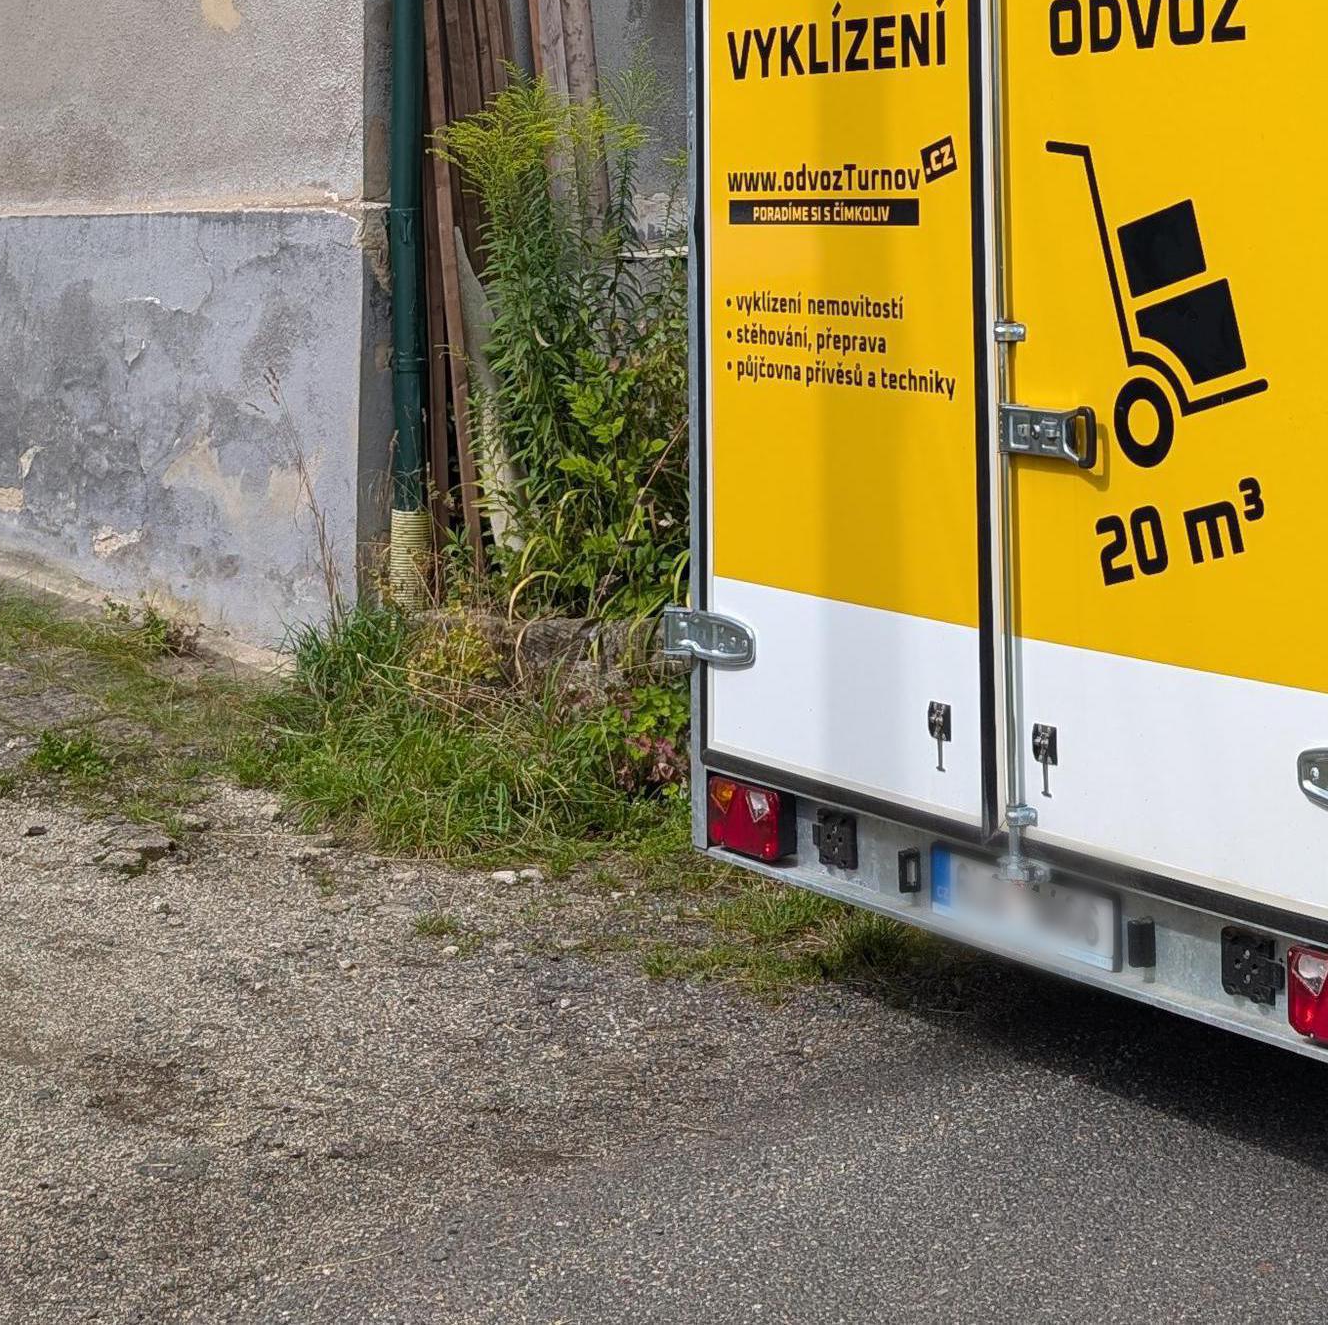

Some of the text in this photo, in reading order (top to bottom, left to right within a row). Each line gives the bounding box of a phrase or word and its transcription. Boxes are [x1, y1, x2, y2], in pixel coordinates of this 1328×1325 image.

[752, 201, 891, 222] PORADÍME SI S ČÍMKOLIV
[736, 290, 904, 320] vyklízení nemovitostí
[736, 323, 886, 356] stěhování, přeprava
[736, 355, 956, 401] půjčovna přívěsů a techniky
[1096, 505, 1170, 586] 20
